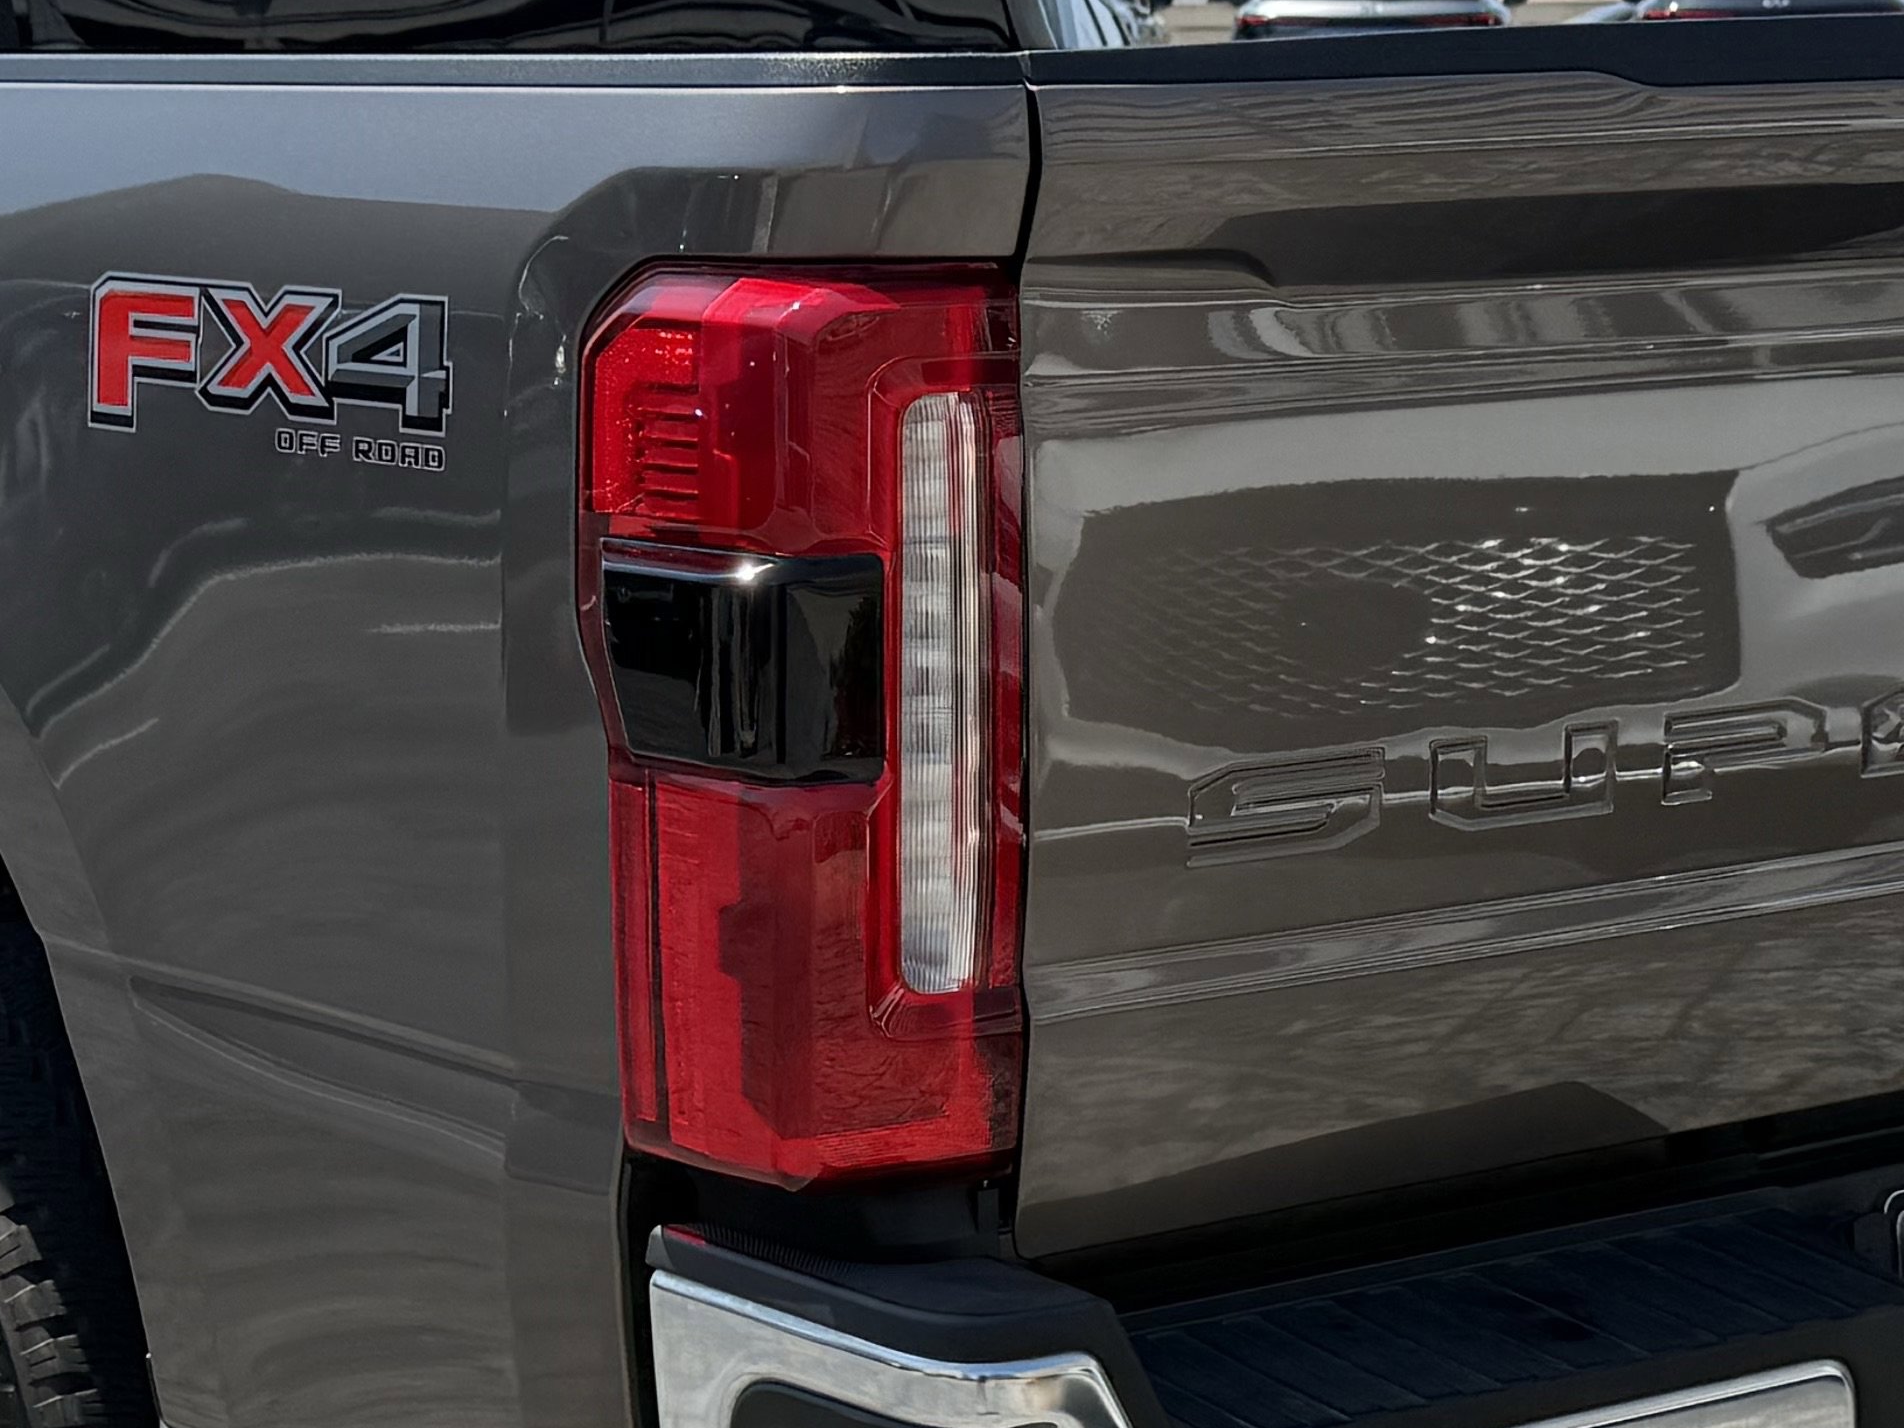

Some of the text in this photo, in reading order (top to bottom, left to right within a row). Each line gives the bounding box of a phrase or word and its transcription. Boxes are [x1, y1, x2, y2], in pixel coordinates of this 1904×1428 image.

[88, 271, 453, 437] FX4
[274, 427, 447, 472] OFF ROAD
